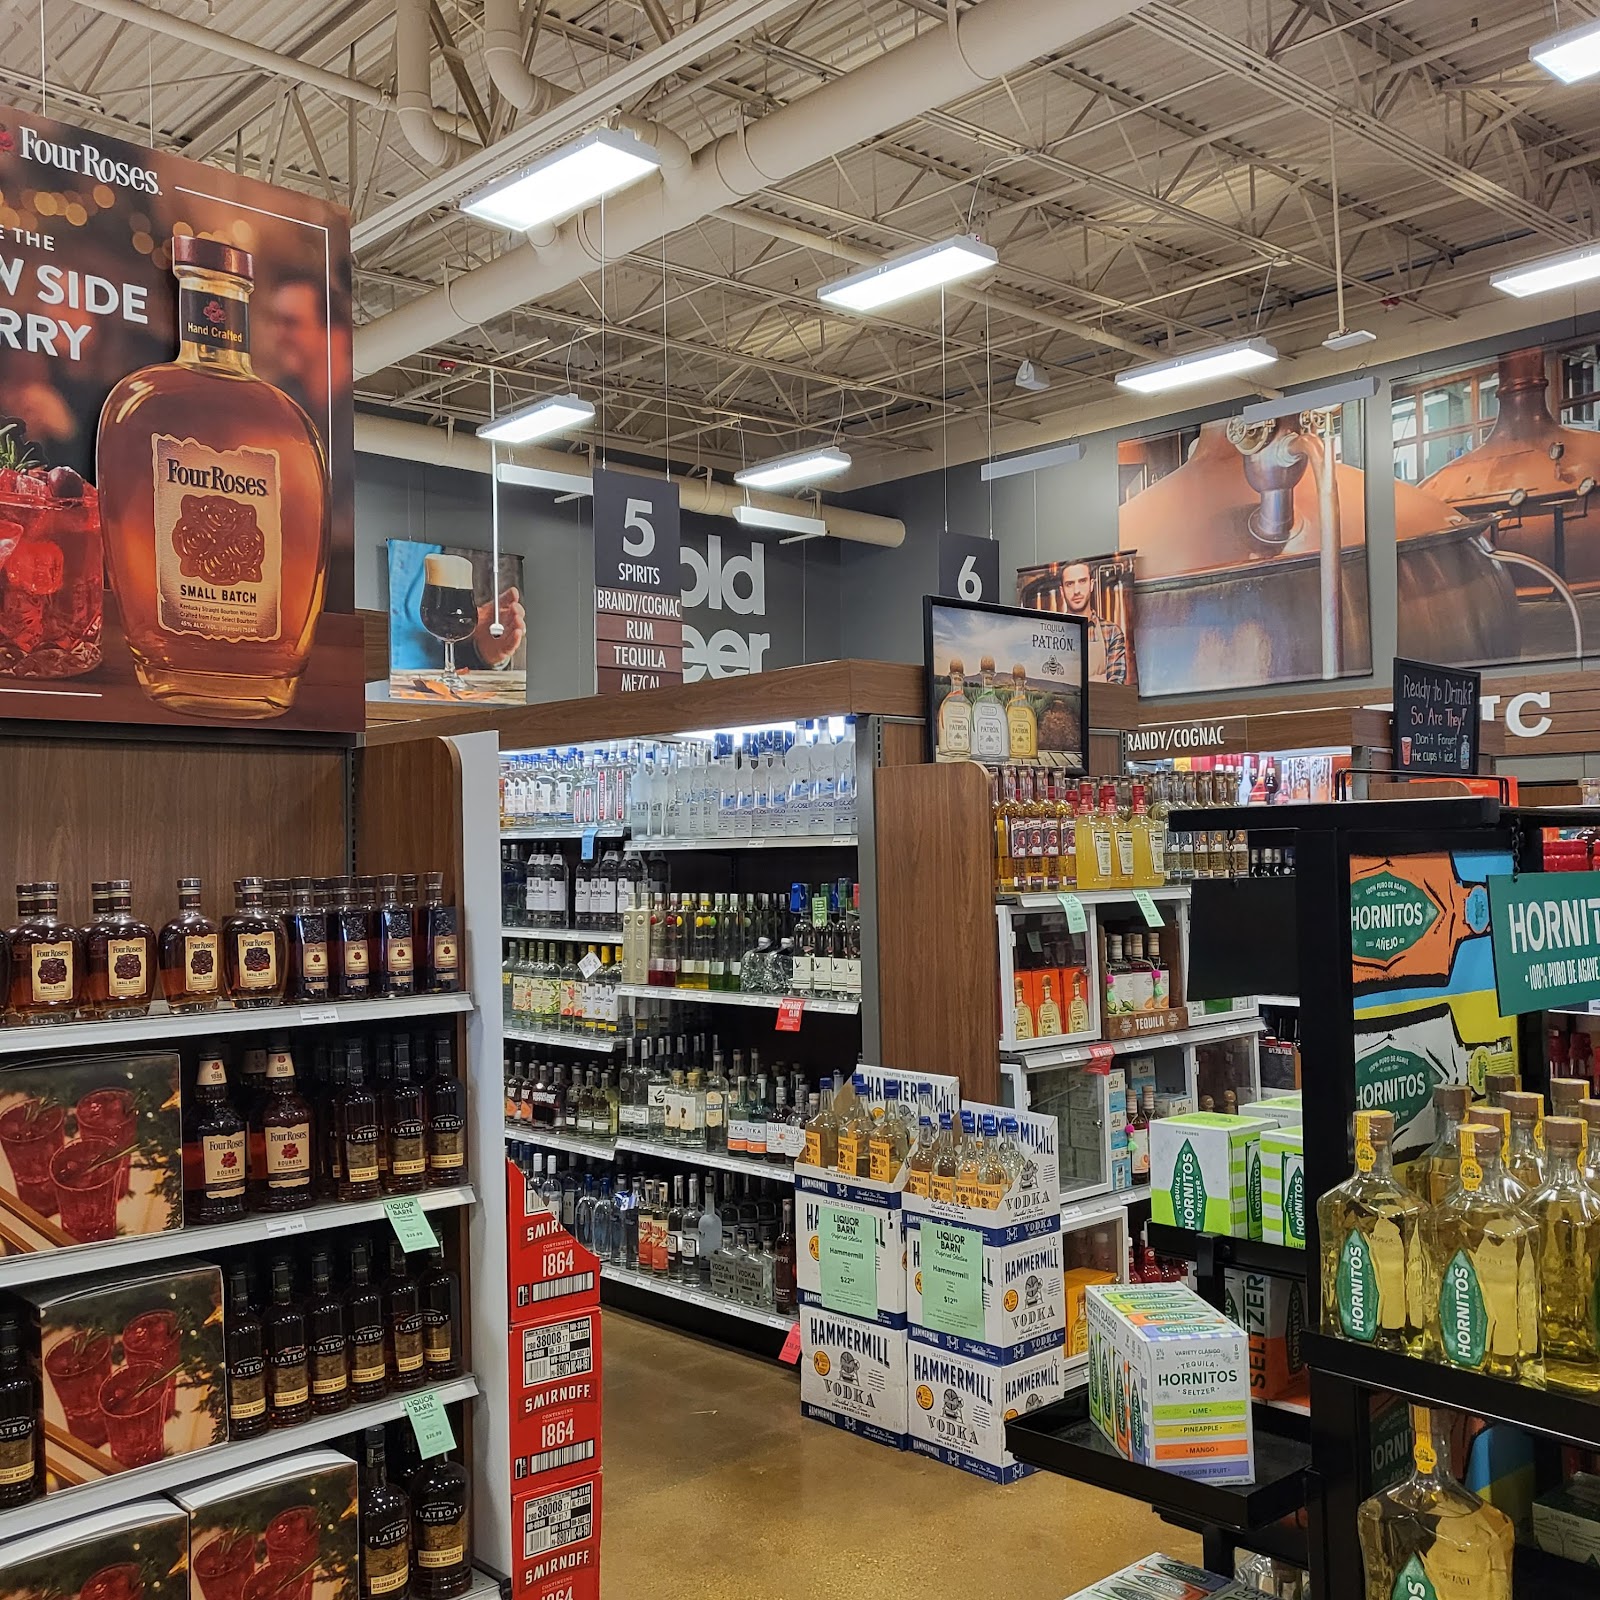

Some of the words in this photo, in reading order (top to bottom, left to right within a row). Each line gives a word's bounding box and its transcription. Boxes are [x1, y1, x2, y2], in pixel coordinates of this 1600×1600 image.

[13, 227, 55, 252] THE
[37, 264, 148, 325] SIDE
[0, 307, 92, 361] RRY
[187, 321, 209, 336] Hand
[211, 325, 243, 343] Crafted
[623, 498, 656, 557] 5
[618, 562, 660, 585] SPIRITS
[957, 555, 983, 602] 6
[180, 584, 217, 600] SMALL
[222, 589, 257, 604] BATCH
[597, 589, 681, 618] BRANDY/COGNAC
[626, 620, 654, 641] RUM
[1040, 622, 1065, 634] TEQUILA
[1032, 634, 1074, 651] PATRÓN
[613, 645, 667, 669] TEQUILA
[1403, 674, 1431, 708] Ready
[1432, 679, 1442, 702] to
[1445, 679, 1473, 706] Drink?
[1411, 705, 1424, 726] So
[1427, 707, 1443, 726] Are
[1127, 726, 1225, 751] RANDY/COGNAC
[1415, 733, 1434, 745] Don't
[1438, 733, 1457, 751] Forget
[1411, 749, 1421, 761] the
[1422, 751, 1437, 765] cups
[1444, 749, 1457, 764] ice!
[1351, 902, 1423, 931] HORNITOS
[1375, 936, 1398, 951] AÑEJO
[1528, 963, 1548, 990] 100%
[1548, 960, 1568, 988] PURO
[1567, 959, 1578, 984] DE
[1135, 1016, 1165, 1030] TEQUILA
[216, 1167, 240, 1176] BOURBON
[277, 1159, 302, 1167] BOURBON
[801, 1177, 829, 1194] HAMMERMILL
[1183, 1152, 1195, 1230] HORNITOS
[387, 1202, 415, 1211] LIQUOR
[1004, 1189, 1051, 1211] VODKA
[1296, 1176, 1304, 1236] HORNITOS
[393, 1208, 413, 1216] BARN
[833, 1213, 860, 1228] LIQUOR
[836, 1223, 856, 1236] BARN
[1023, 1218, 1053, 1233] VODKA
[936, 1229, 966, 1245] LIQUOR
[940, 1240, 961, 1254] BARN
[542, 1249, 574, 1278] 1864
[829, 1246, 864, 1260] Hammermill
[932, 1264, 970, 1280] Hammermill
[1005, 1247, 1059, 1284] HAMMERMILL
[1350, 1244, 1363, 1333] HORNITOS
[827, 1314, 846, 1323] CRAFTED
[1010, 1304, 1056, 1330] VODKA
[1457, 1266, 1470, 1359] HORNITOS
[536, 1332, 562, 1348] 38008
[1246, 1273, 1266, 1389] SELTZER
[1291, 1290, 1300, 1369] HORNITOS
[810, 1317, 890, 1369] HAMMERMILL
[931, 1351, 948, 1360] CRAFTED
[1181, 1361, 1215, 1369] TEQUILA
[913, 1353, 994, 1406] HAMMERMILL
[1005, 1364, 1060, 1404] HAMMERMILL
[1158, 1369, 1238, 1386] HORNITOS
[407, 1394, 434, 1408] LIQUOR
[525, 1384, 591, 1413] SMIRNOFF
[823, 1378, 876, 1408] VODKA
[1182, 1386, 1216, 1396] SELTZER
[413, 1402, 433, 1413] BARN
[541, 1418, 574, 1449] 1864
[926, 1414, 979, 1446] VODKA
[1183, 1425, 1219, 1433] PINEAPPLE
[1189, 1446, 1215, 1454] MANGO
[1178, 1467, 1207, 1476] PASSION
[1208, 1466, 1228, 1474] FRUIT
[525, 1550, 590, 1585] SMIRNOFF
[1163, 1563, 1208, 1582] HORNITOS
[1140, 1575, 1186, 1595] HORNITOS
